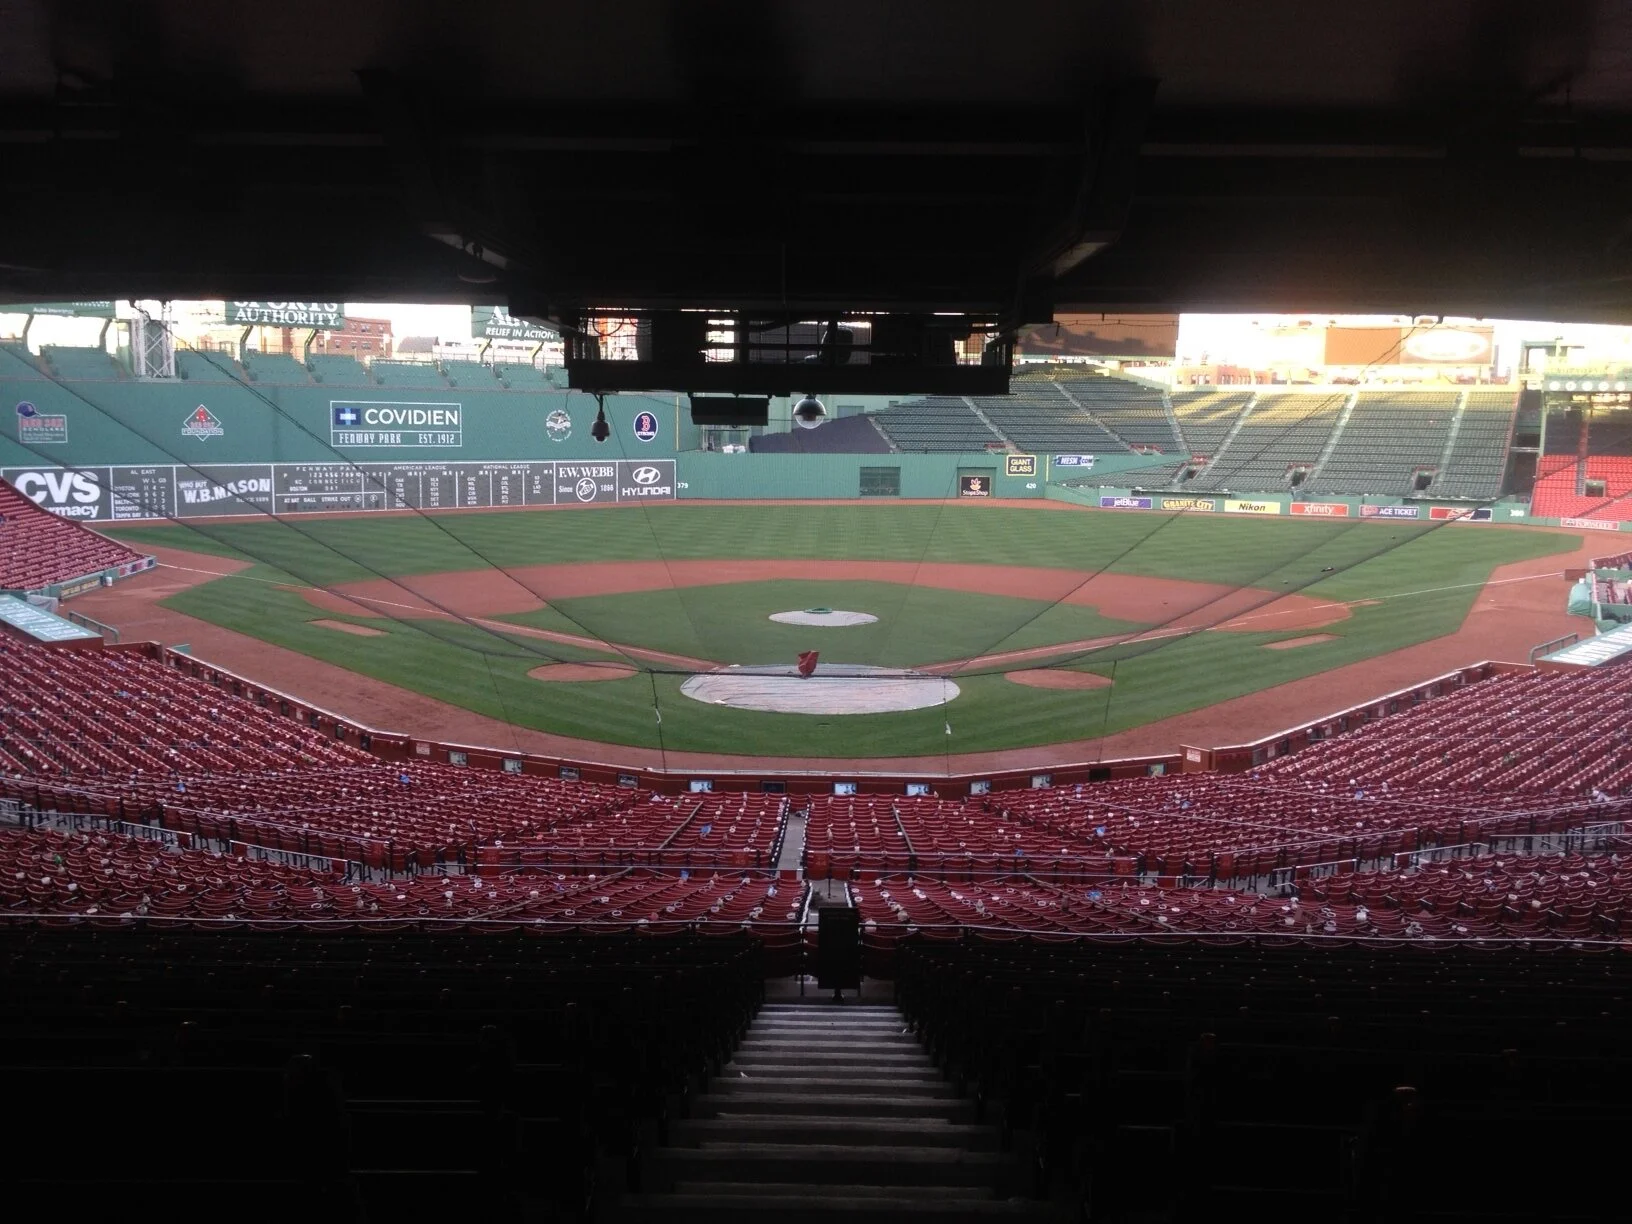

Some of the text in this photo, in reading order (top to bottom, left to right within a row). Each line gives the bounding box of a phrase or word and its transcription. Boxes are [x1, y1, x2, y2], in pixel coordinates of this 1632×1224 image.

[485, 327, 511, 336] RELIEF
[523, 330, 554, 340] ACTION
[365, 408, 459, 425] COVIDIEN
[340, 432, 455, 444] FENWAY PARK EST. 1912
[559, 466, 614, 477] F.W. WEBB
[15, 471, 100, 503] CVS
[559, 485, 573, 493] Since
[622, 486, 671, 496] HYUNDAI
[1114, 499, 1139, 507] jetBlue
[1163, 500, 1213, 510] GRANITE CITY
[1238, 503, 1266, 512] Nikon
[48, 505, 99, 518] rmacy
[1304, 504, 1334, 514] xfinity
[1394, 508, 1418, 516] TICKET
